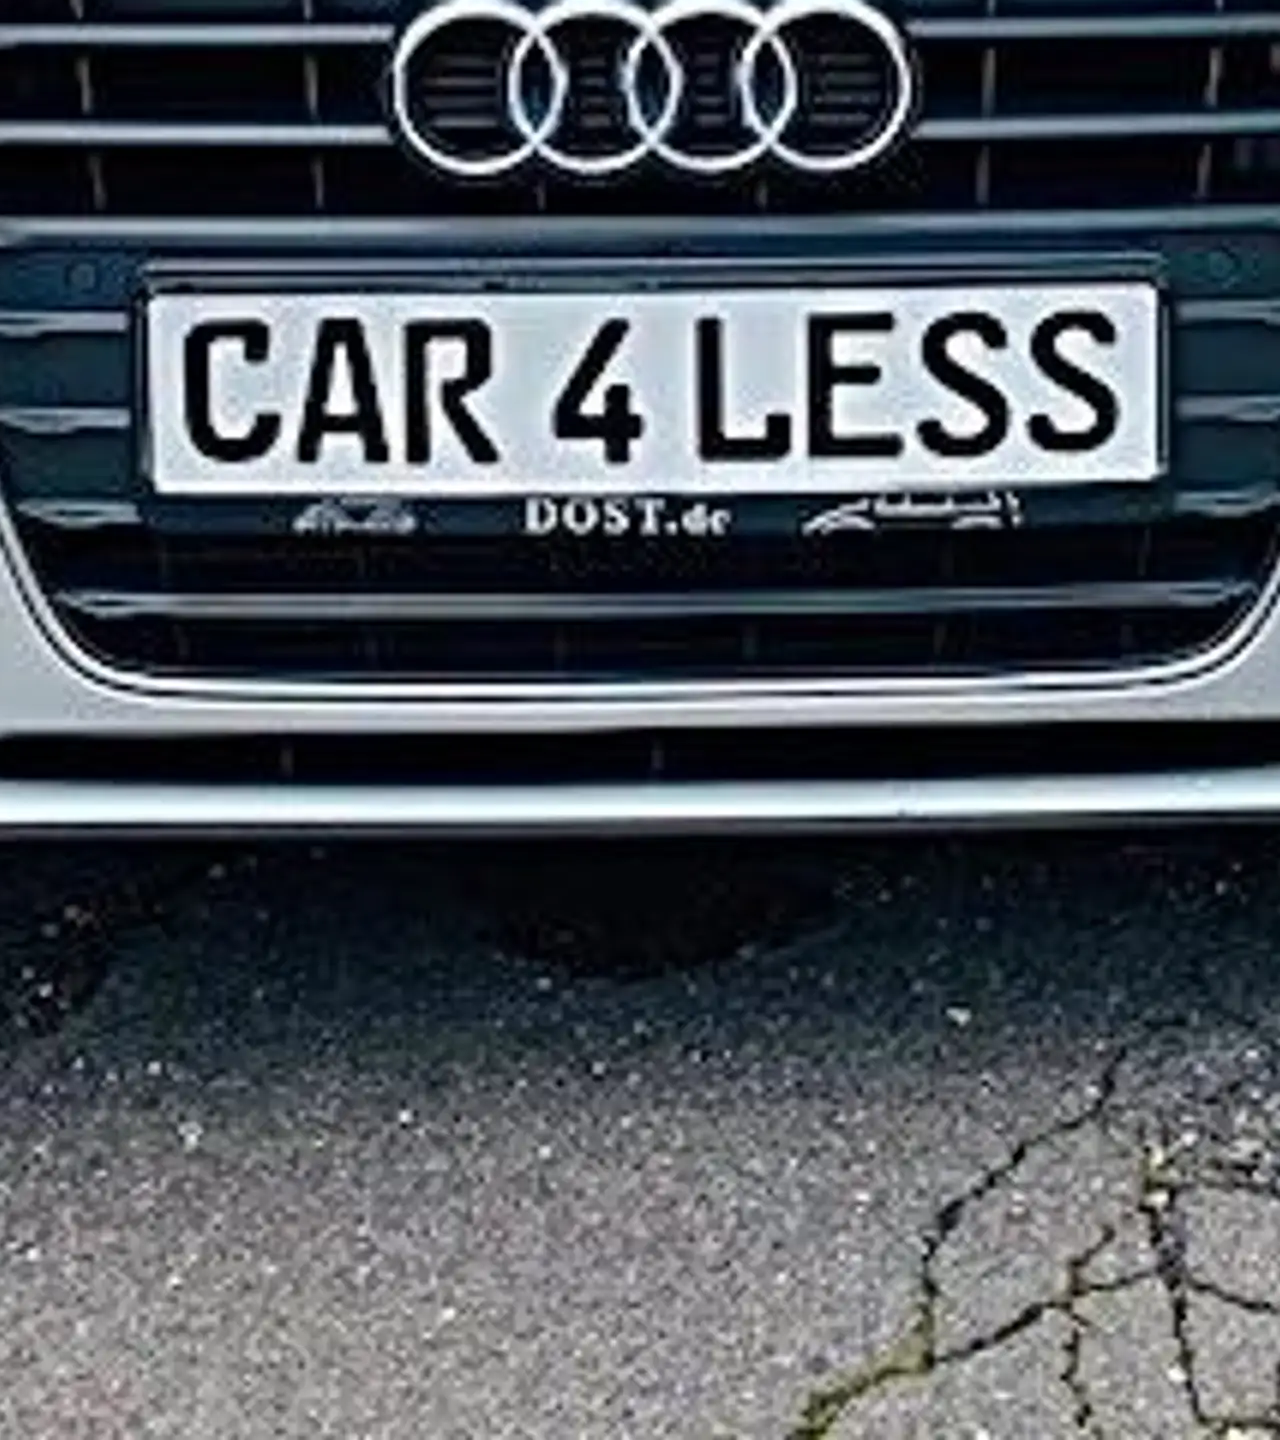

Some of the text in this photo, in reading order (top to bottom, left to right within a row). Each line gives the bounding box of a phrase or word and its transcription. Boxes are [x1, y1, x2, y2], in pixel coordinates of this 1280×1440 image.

[183, 310, 1119, 465] CAR 4 LESS
[524, 497, 732, 536] DOST.de
